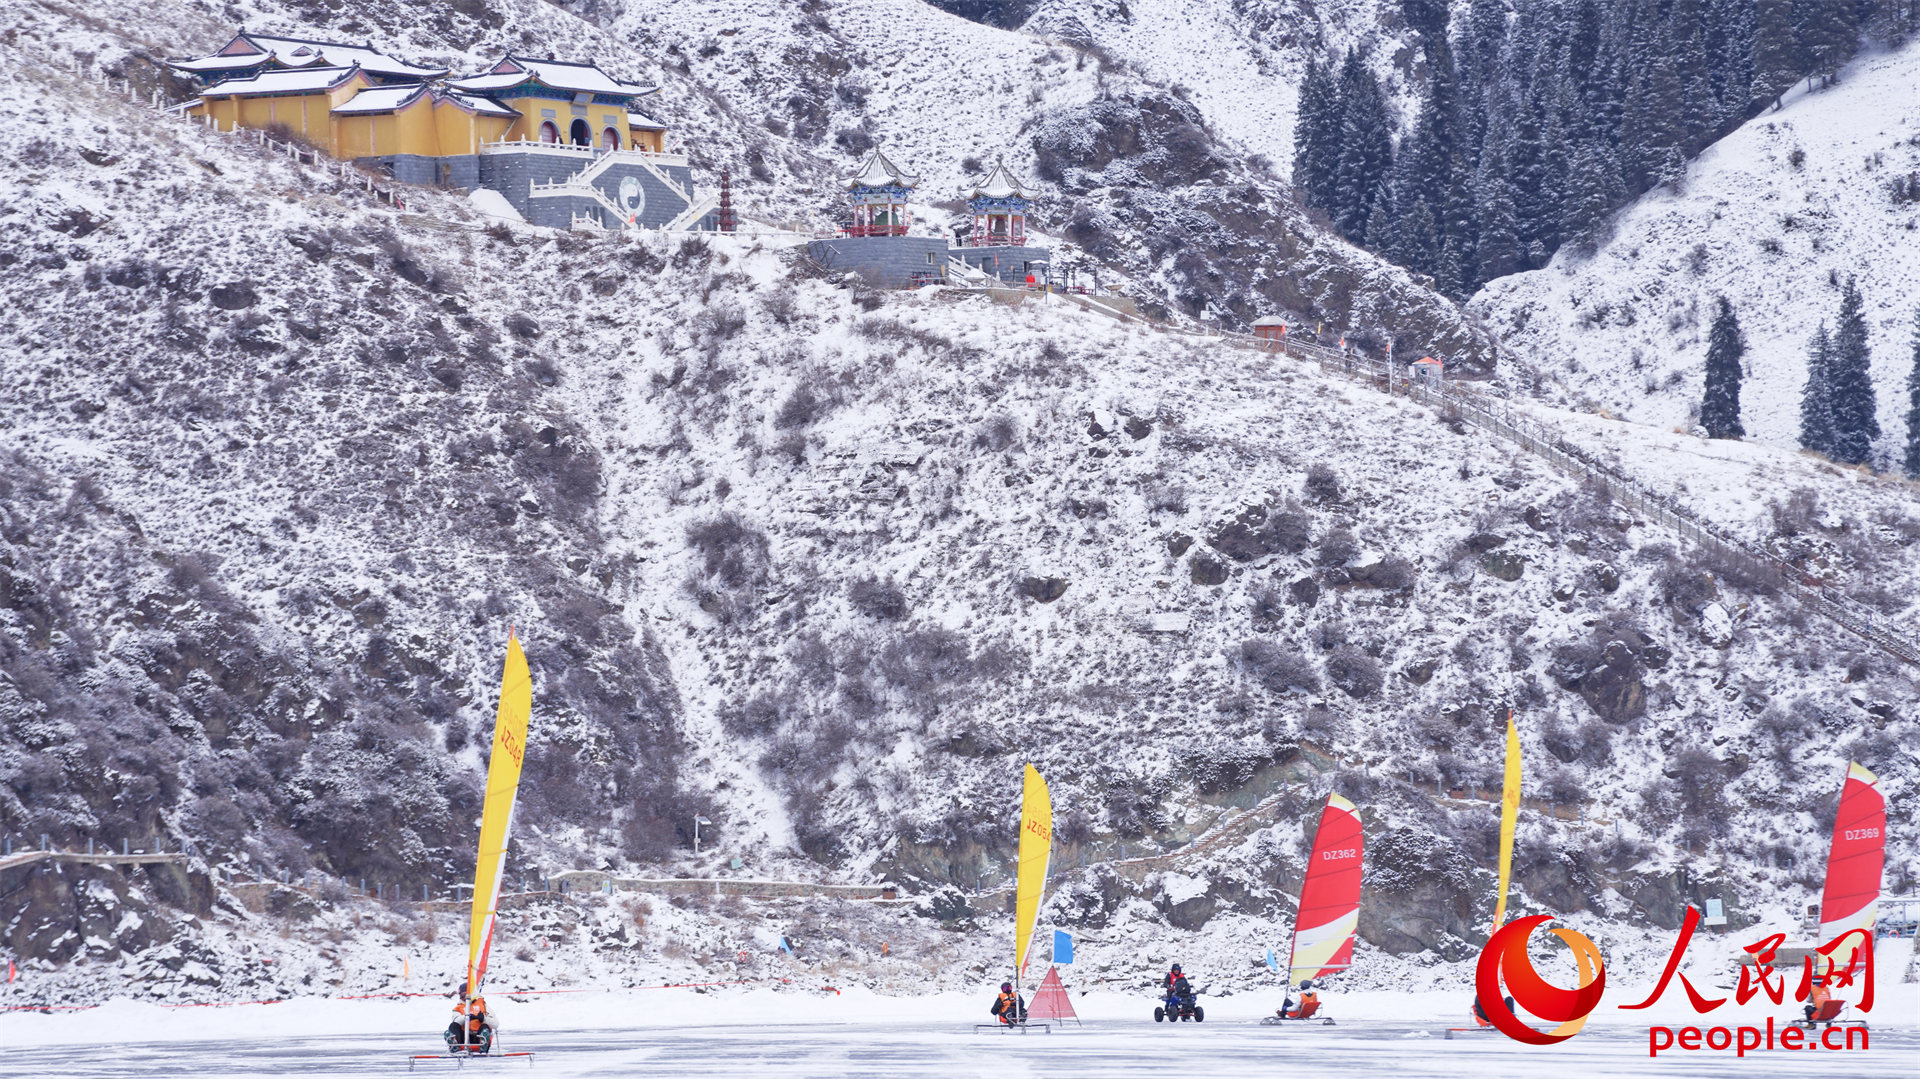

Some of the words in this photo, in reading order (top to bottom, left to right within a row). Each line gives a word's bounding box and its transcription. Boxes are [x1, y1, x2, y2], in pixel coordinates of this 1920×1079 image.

[1026, 817, 1051, 843] JZ054
[1845, 828, 1879, 841] DZ369
[1322, 849, 1357, 861] DZ362
